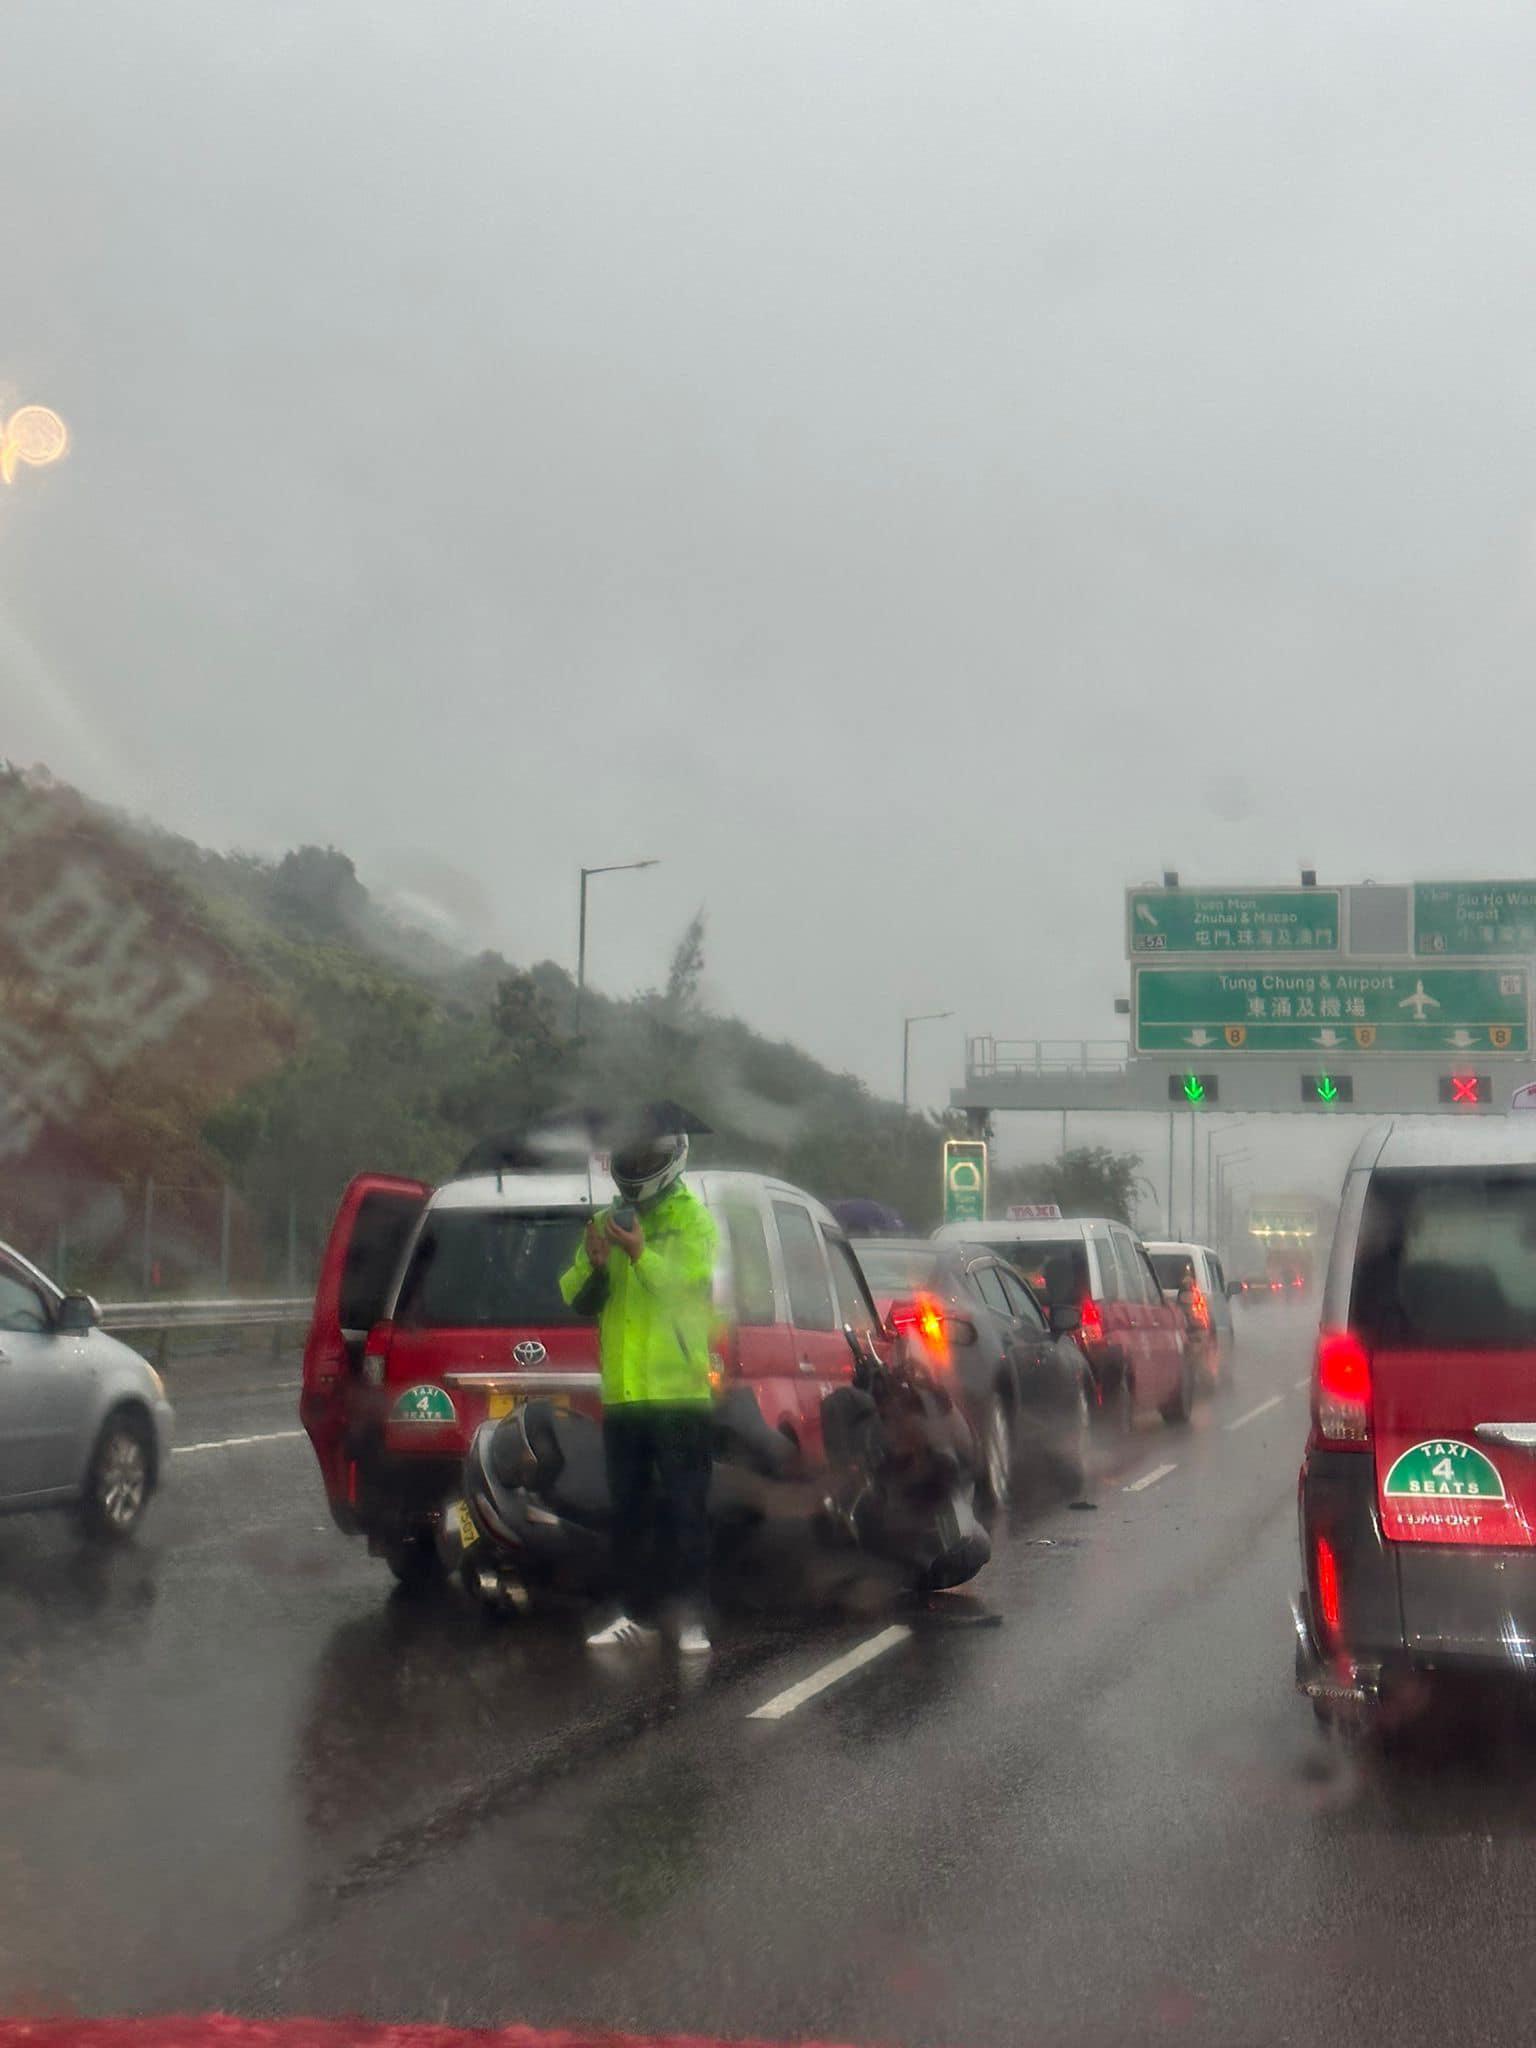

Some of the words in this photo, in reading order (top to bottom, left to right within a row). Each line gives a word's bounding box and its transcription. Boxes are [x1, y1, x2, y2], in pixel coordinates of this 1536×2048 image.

[1194, 912, 1236, 925] Zhuhai
[1240, 913, 1250, 924] &
[1219, 976, 1257, 992] Tung
[1262, 976, 1315, 992] Chung
[1320, 976, 1331, 989] &
[1336, 976, 1395, 992] Airport
[1248, 997, 1366, 1017] 東涌及機場
[1230, 1030, 1240, 1043] 8
[1360, 1030, 1370, 1043] 8
[1495, 1030, 1506, 1044] 8
[1011, 1206, 1056, 1217] TAXI
[412, 1388, 439, 1398] TAXI
[416, 1396, 429, 1410] 4
[1421, 1443, 1468, 1458] TAXI
[1432, 1458, 1455, 1480] 4
[1409, 1480, 1479, 1494] SEATS
